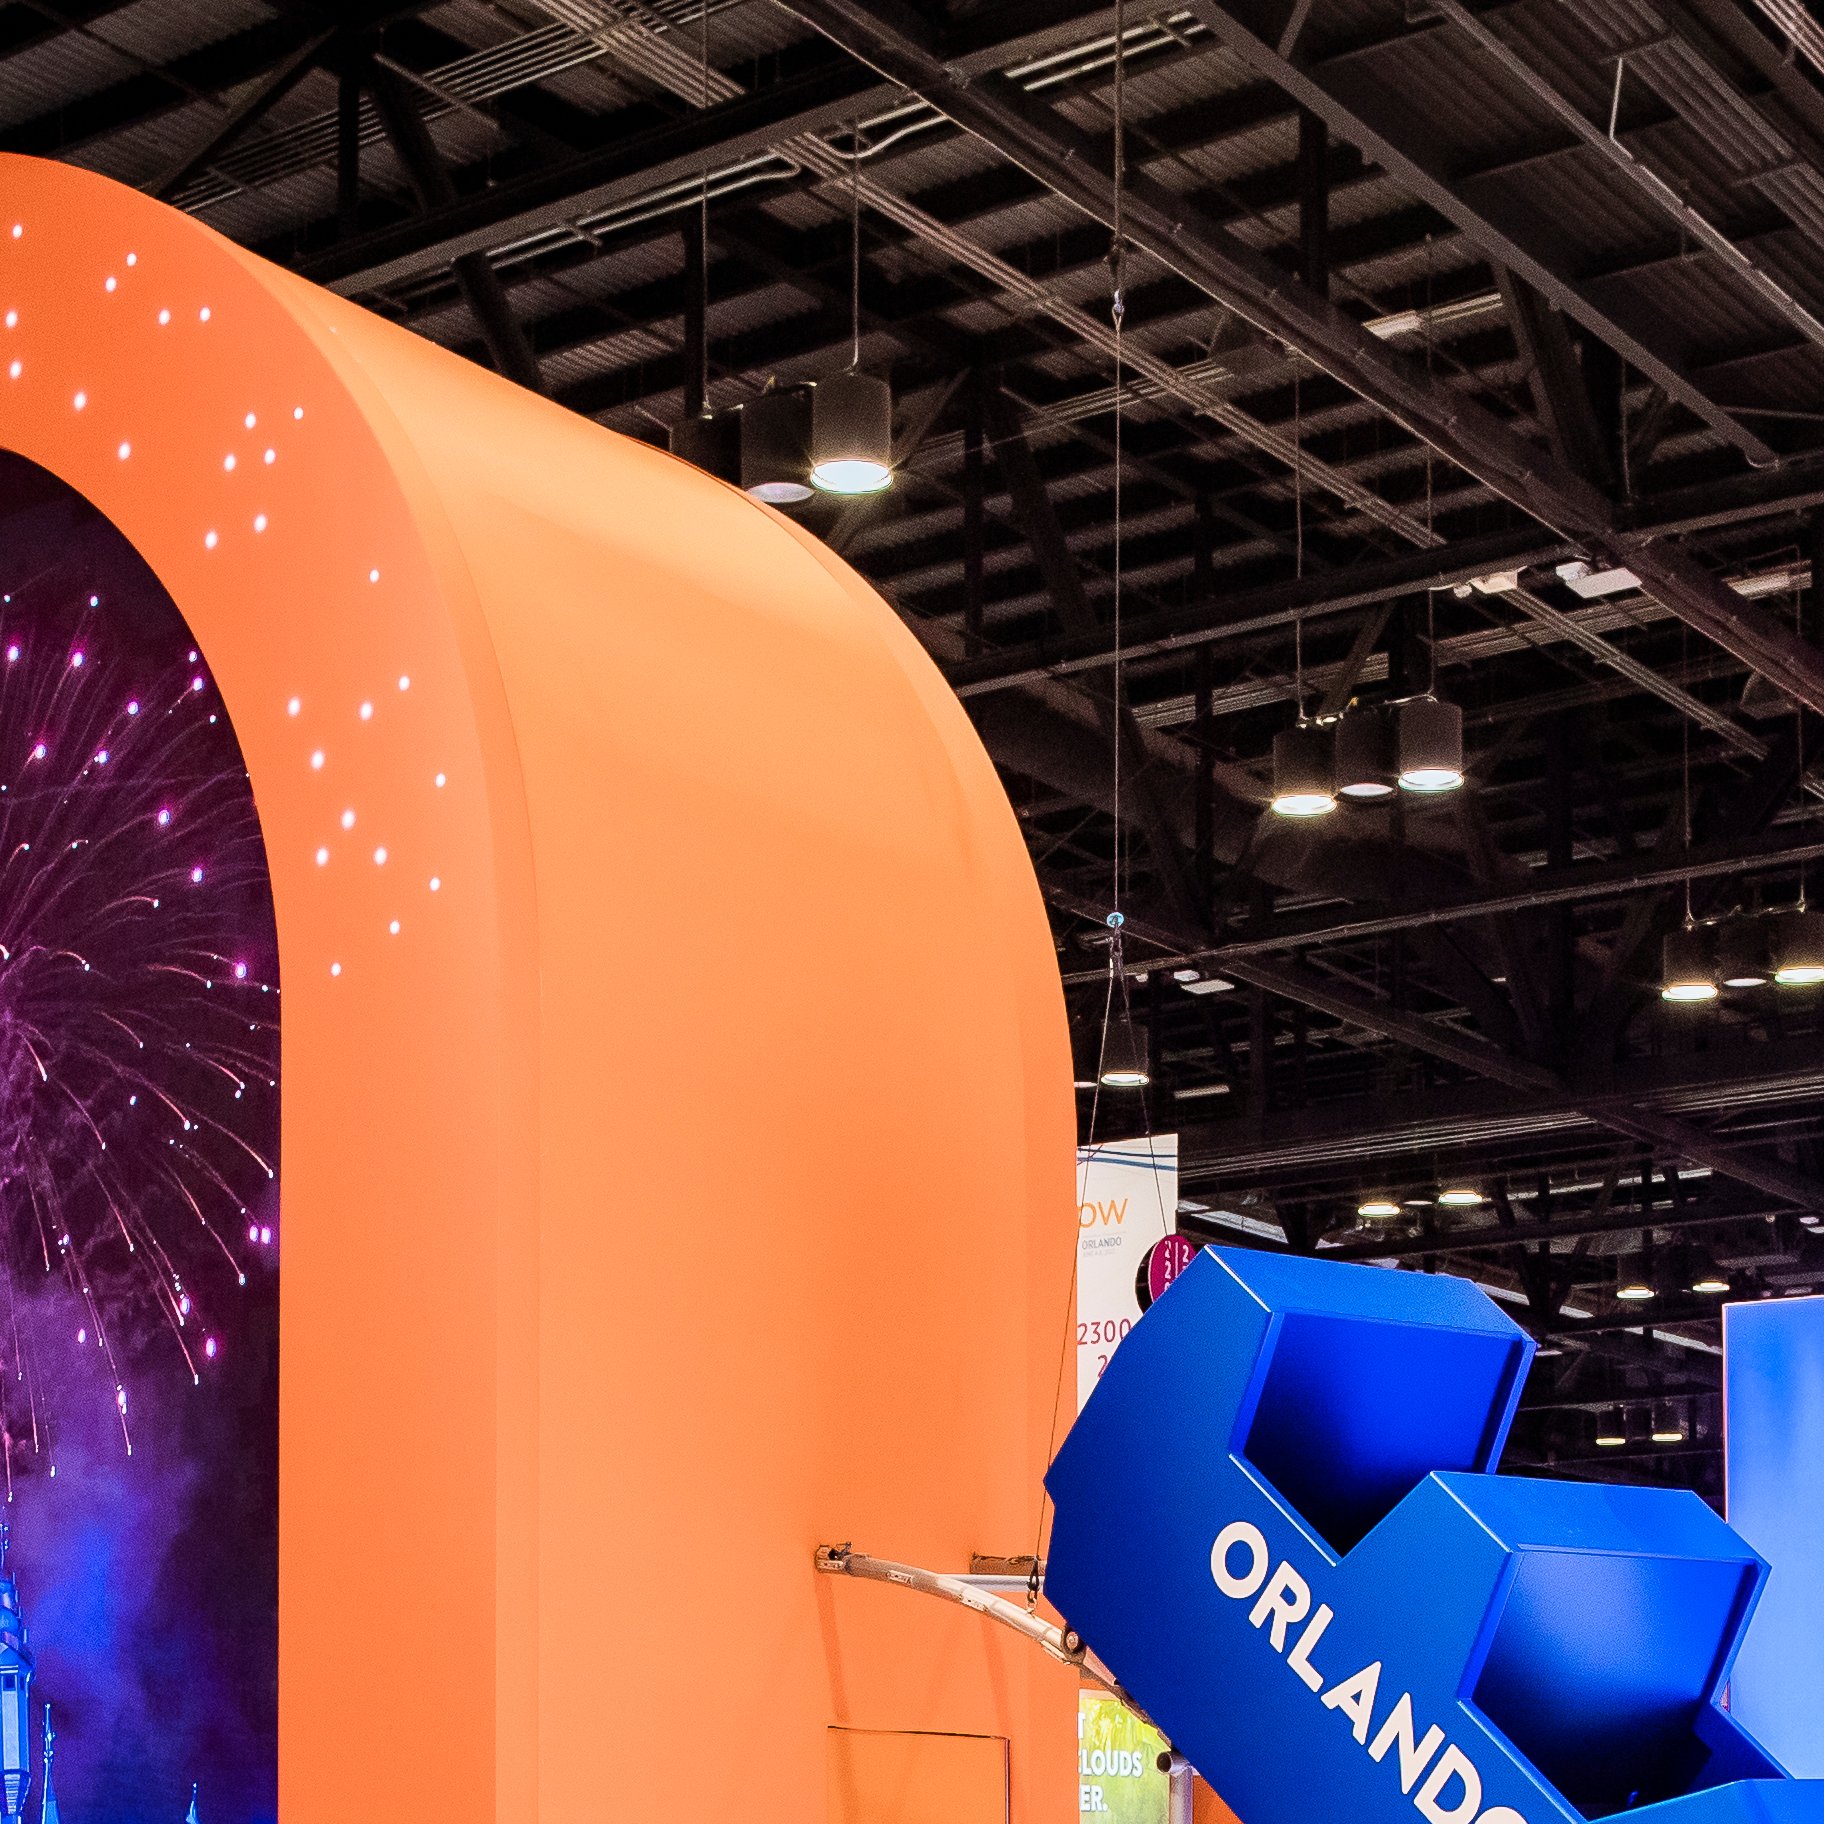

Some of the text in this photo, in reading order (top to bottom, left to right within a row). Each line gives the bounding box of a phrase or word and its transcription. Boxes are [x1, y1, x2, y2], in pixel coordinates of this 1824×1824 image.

[1081, 1236, 1122, 1250] ORLANDO
[1076, 1318, 1132, 1346] 2300
[1078, 1749, 1143, 1777] LOUDS
